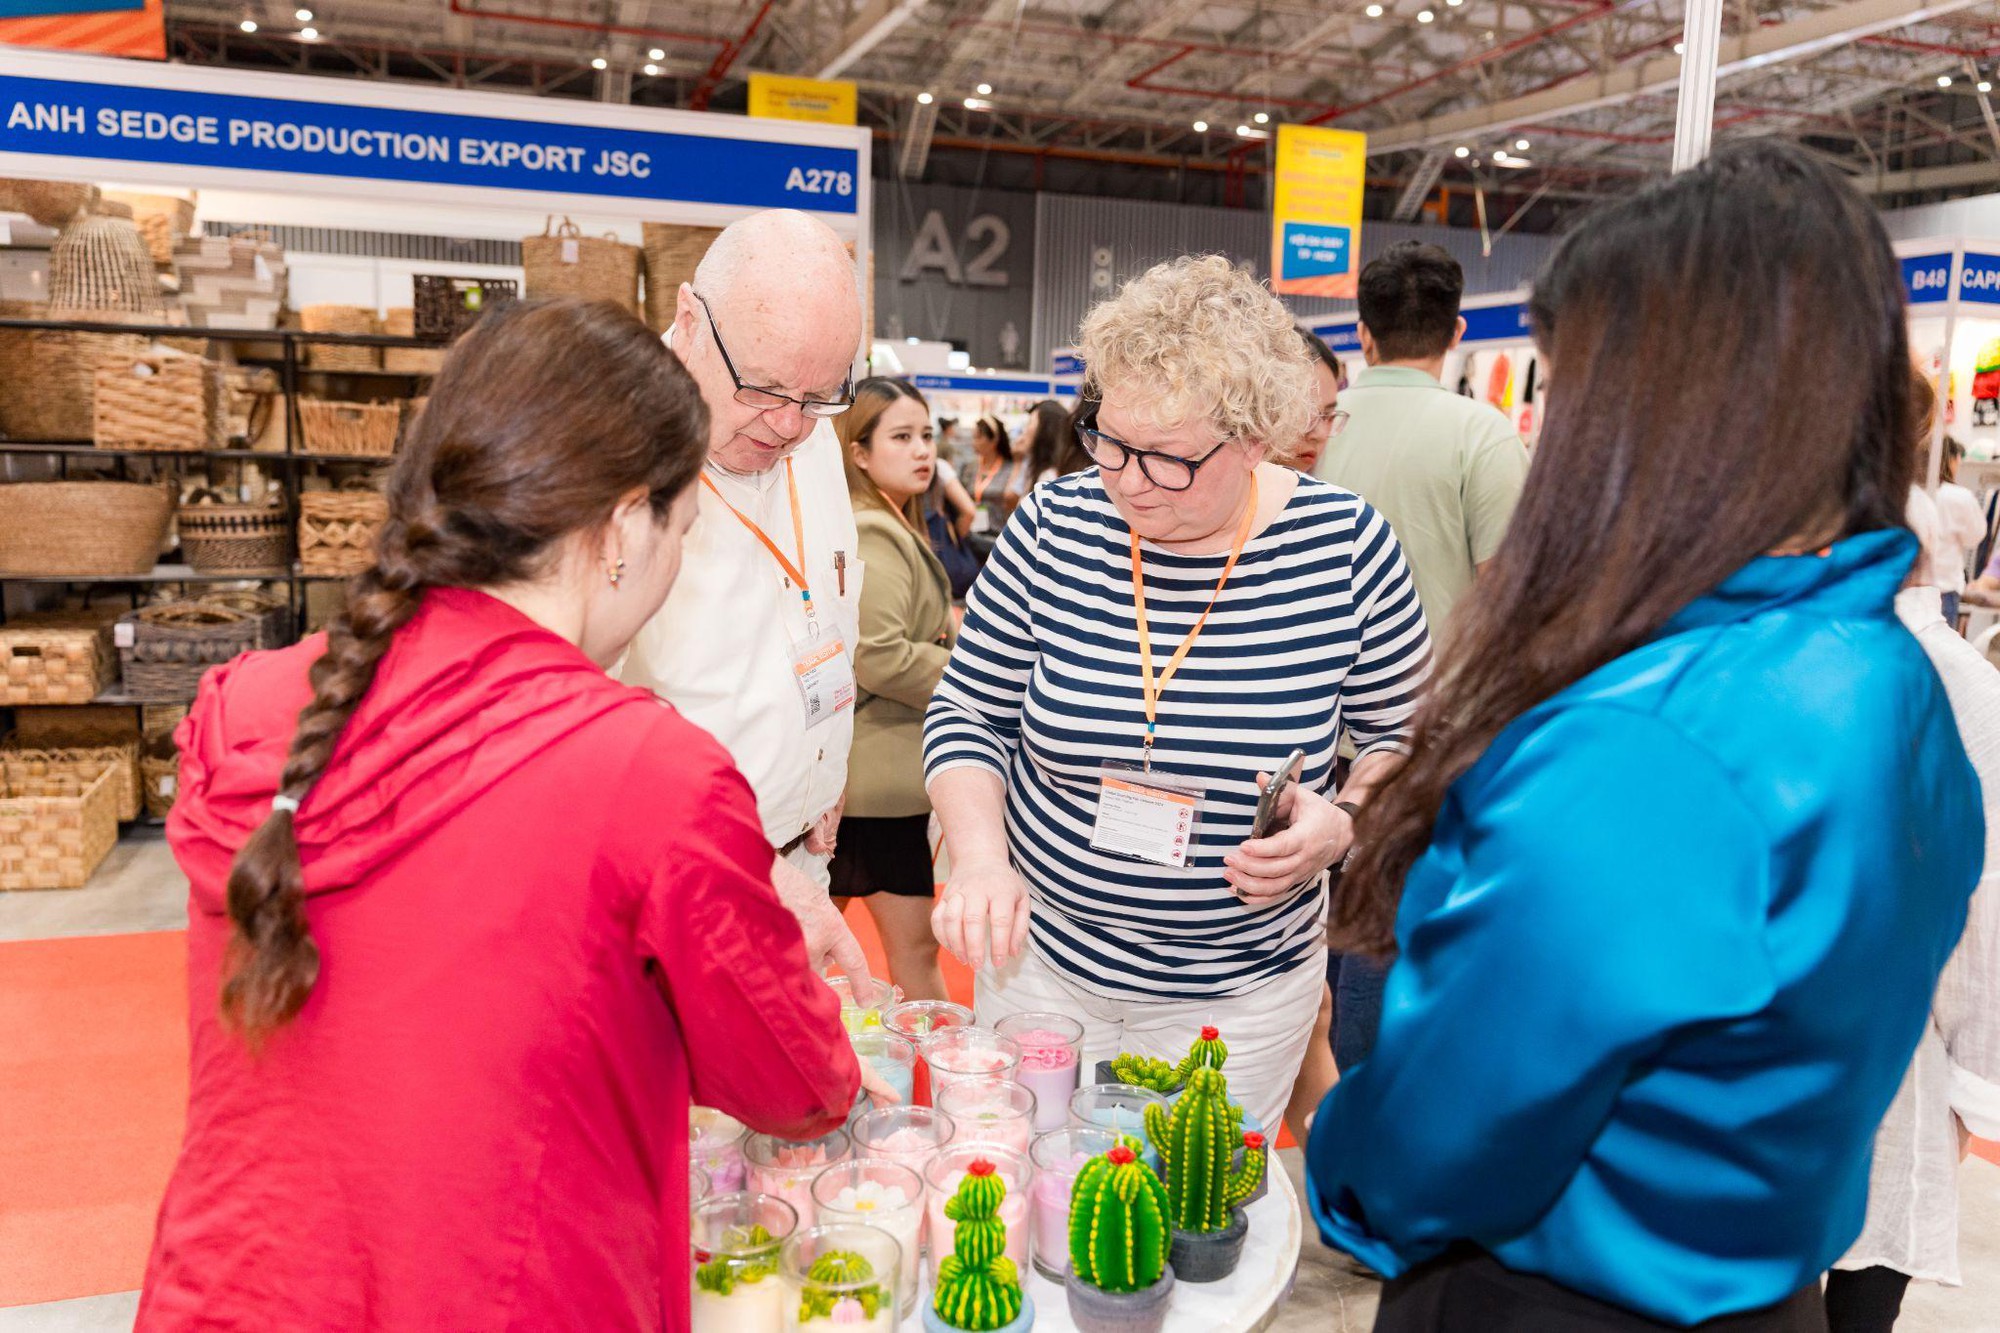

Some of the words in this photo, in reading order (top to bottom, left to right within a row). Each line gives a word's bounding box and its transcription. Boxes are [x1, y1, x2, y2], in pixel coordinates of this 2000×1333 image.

[7, 101, 86, 134] ANH
[96, 107, 220, 145] SEDGE
[229, 118, 450, 163] PRODUCTION
[458, 138, 586, 173] EXPORT
[592, 150, 651, 179] JSC
[784, 166, 853, 197] A278
[898, 208, 1011, 287] A2
[1912, 267, 1947, 290] B48
